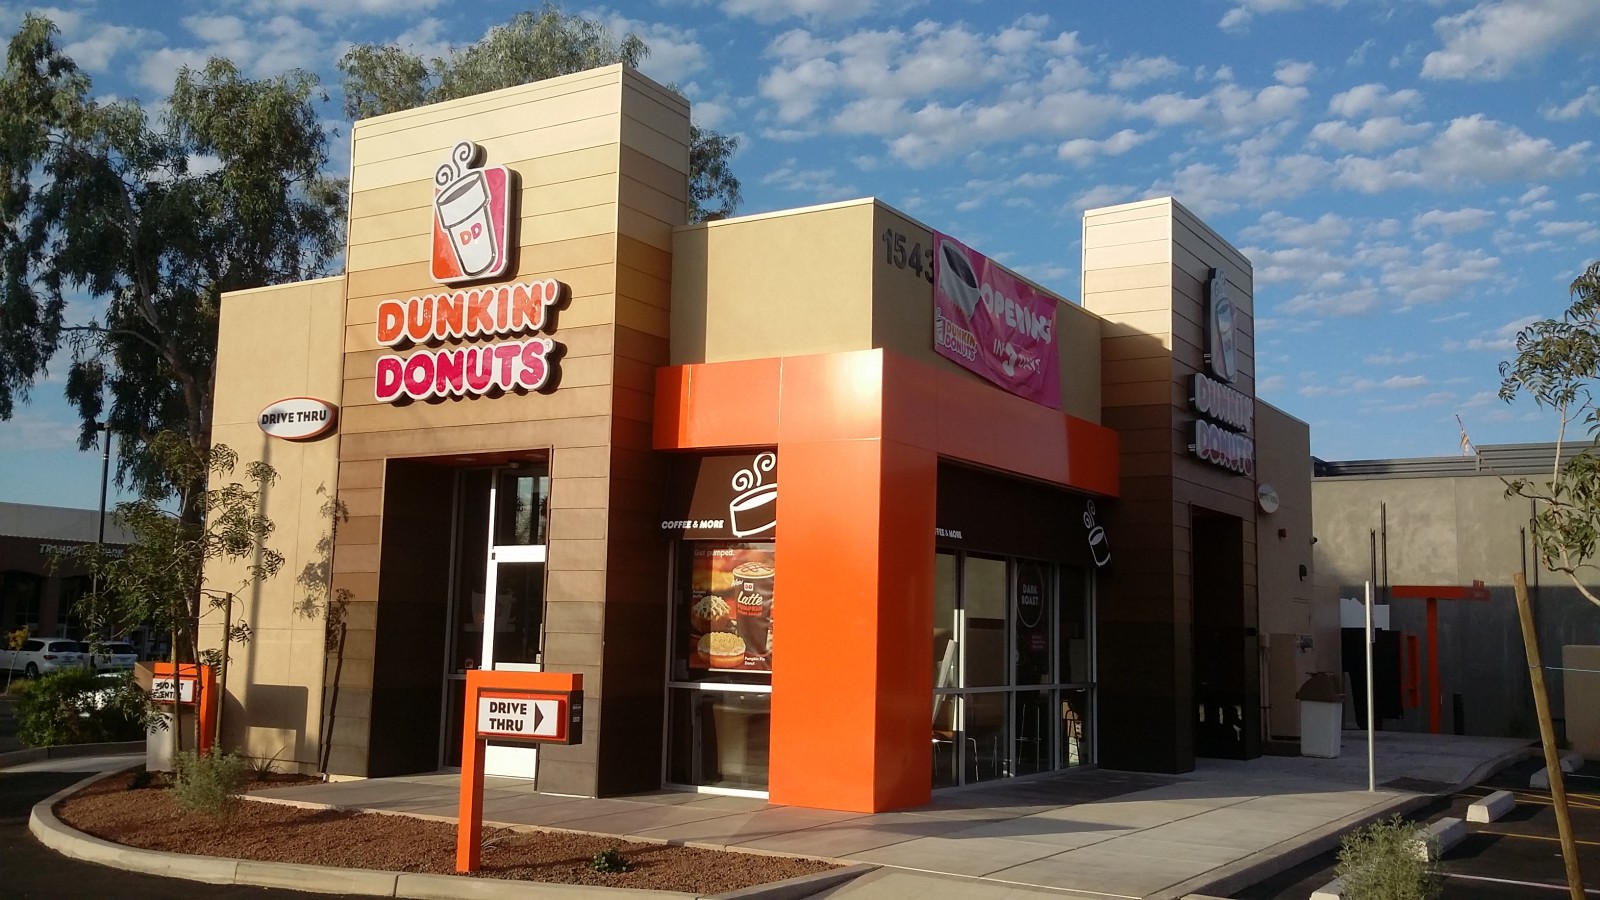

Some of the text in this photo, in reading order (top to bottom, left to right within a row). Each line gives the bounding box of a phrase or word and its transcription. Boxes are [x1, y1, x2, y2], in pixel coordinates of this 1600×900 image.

[460, 223, 482, 245] DD
[377, 281, 557, 343] DUNKIN'
[980, 283, 1052, 344] OPENING
[376, 341, 547, 399] DONUTS
[262, 409, 327, 425] DRIVE THRU
[661, 520, 725, 529] COFFEE & MORE
[1022, 583, 1038, 594] DARK
[1021, 594, 1039, 606] ROAST
[170, 682, 185, 690] NT
[489, 701, 527, 715] DRIVE
[489, 718, 524, 732] THRU
